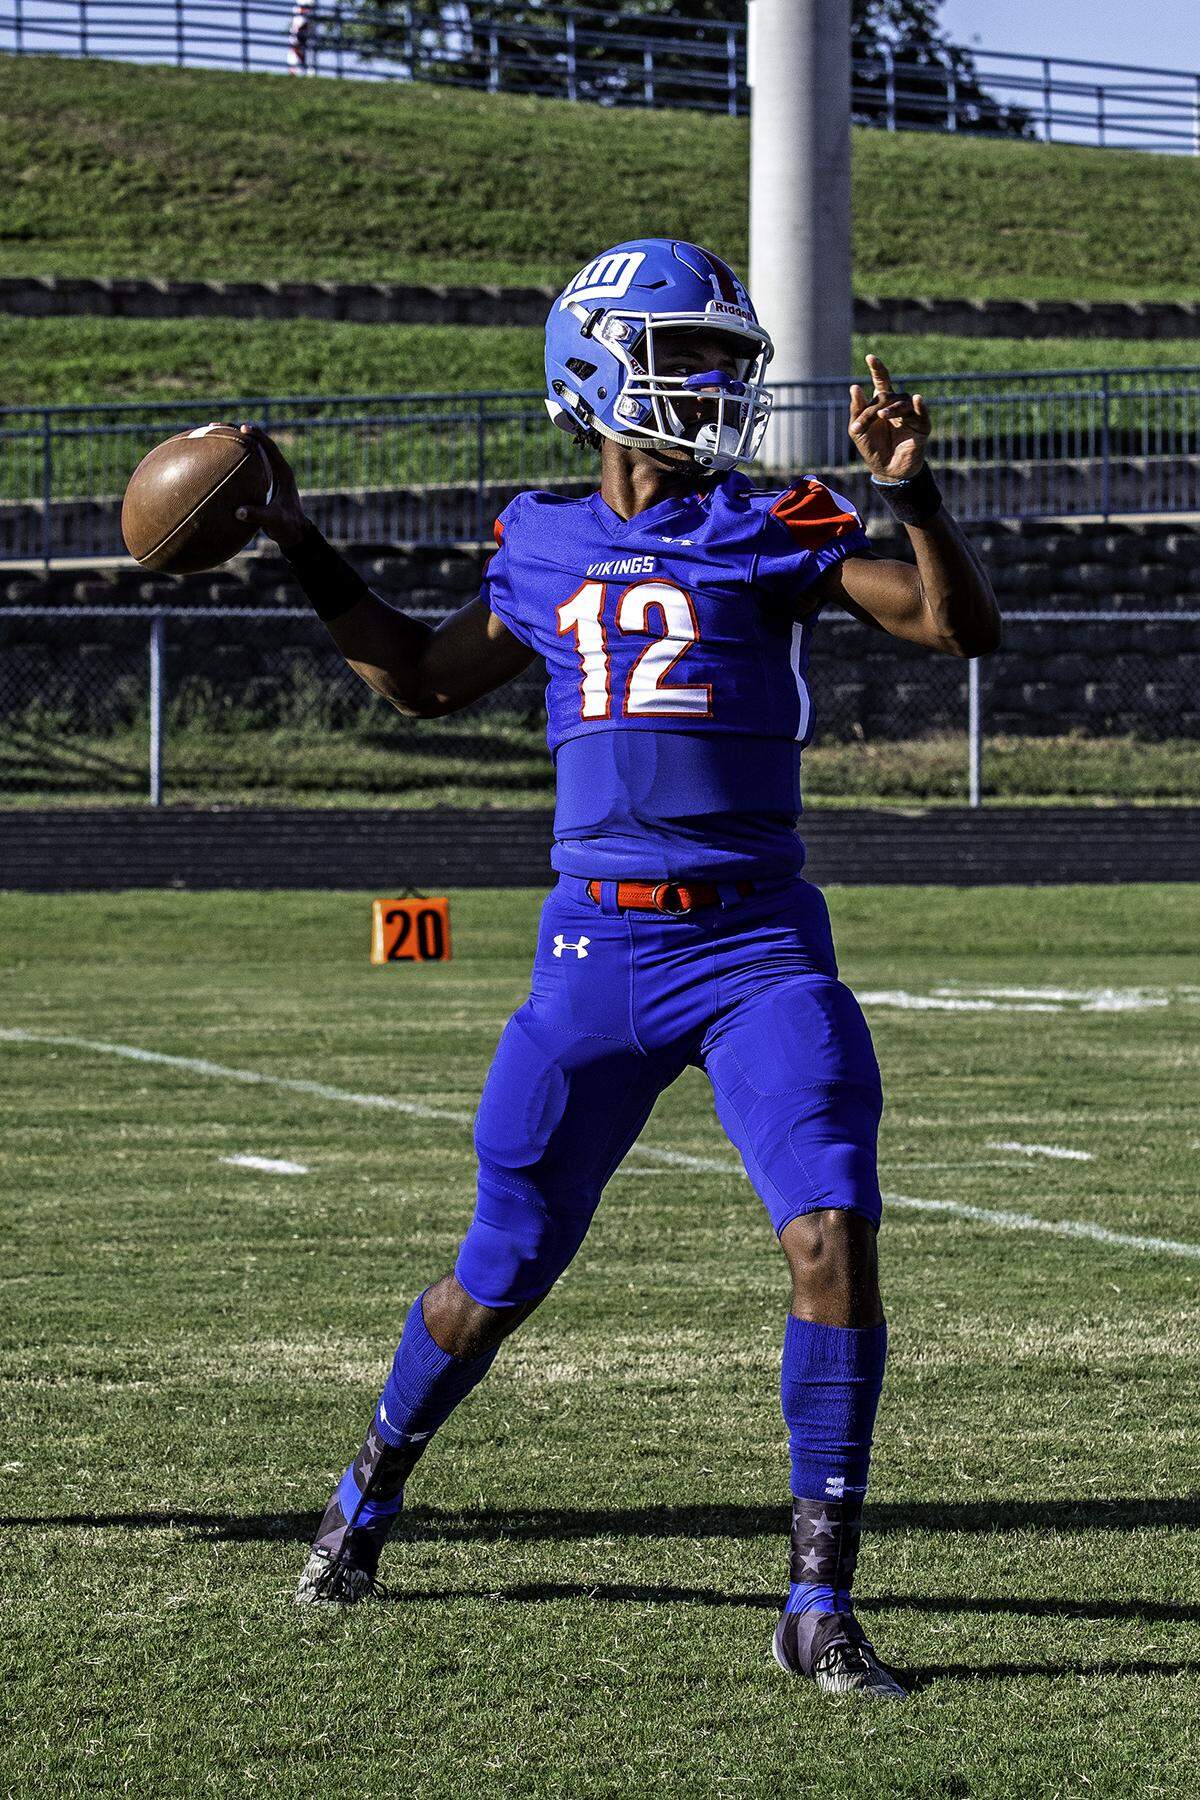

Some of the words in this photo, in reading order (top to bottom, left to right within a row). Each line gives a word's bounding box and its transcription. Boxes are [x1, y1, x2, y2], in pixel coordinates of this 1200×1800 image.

[586, 555, 655, 576] VIKINGS
[555, 577, 714, 721] 12
[386, 909, 443, 961] 20
